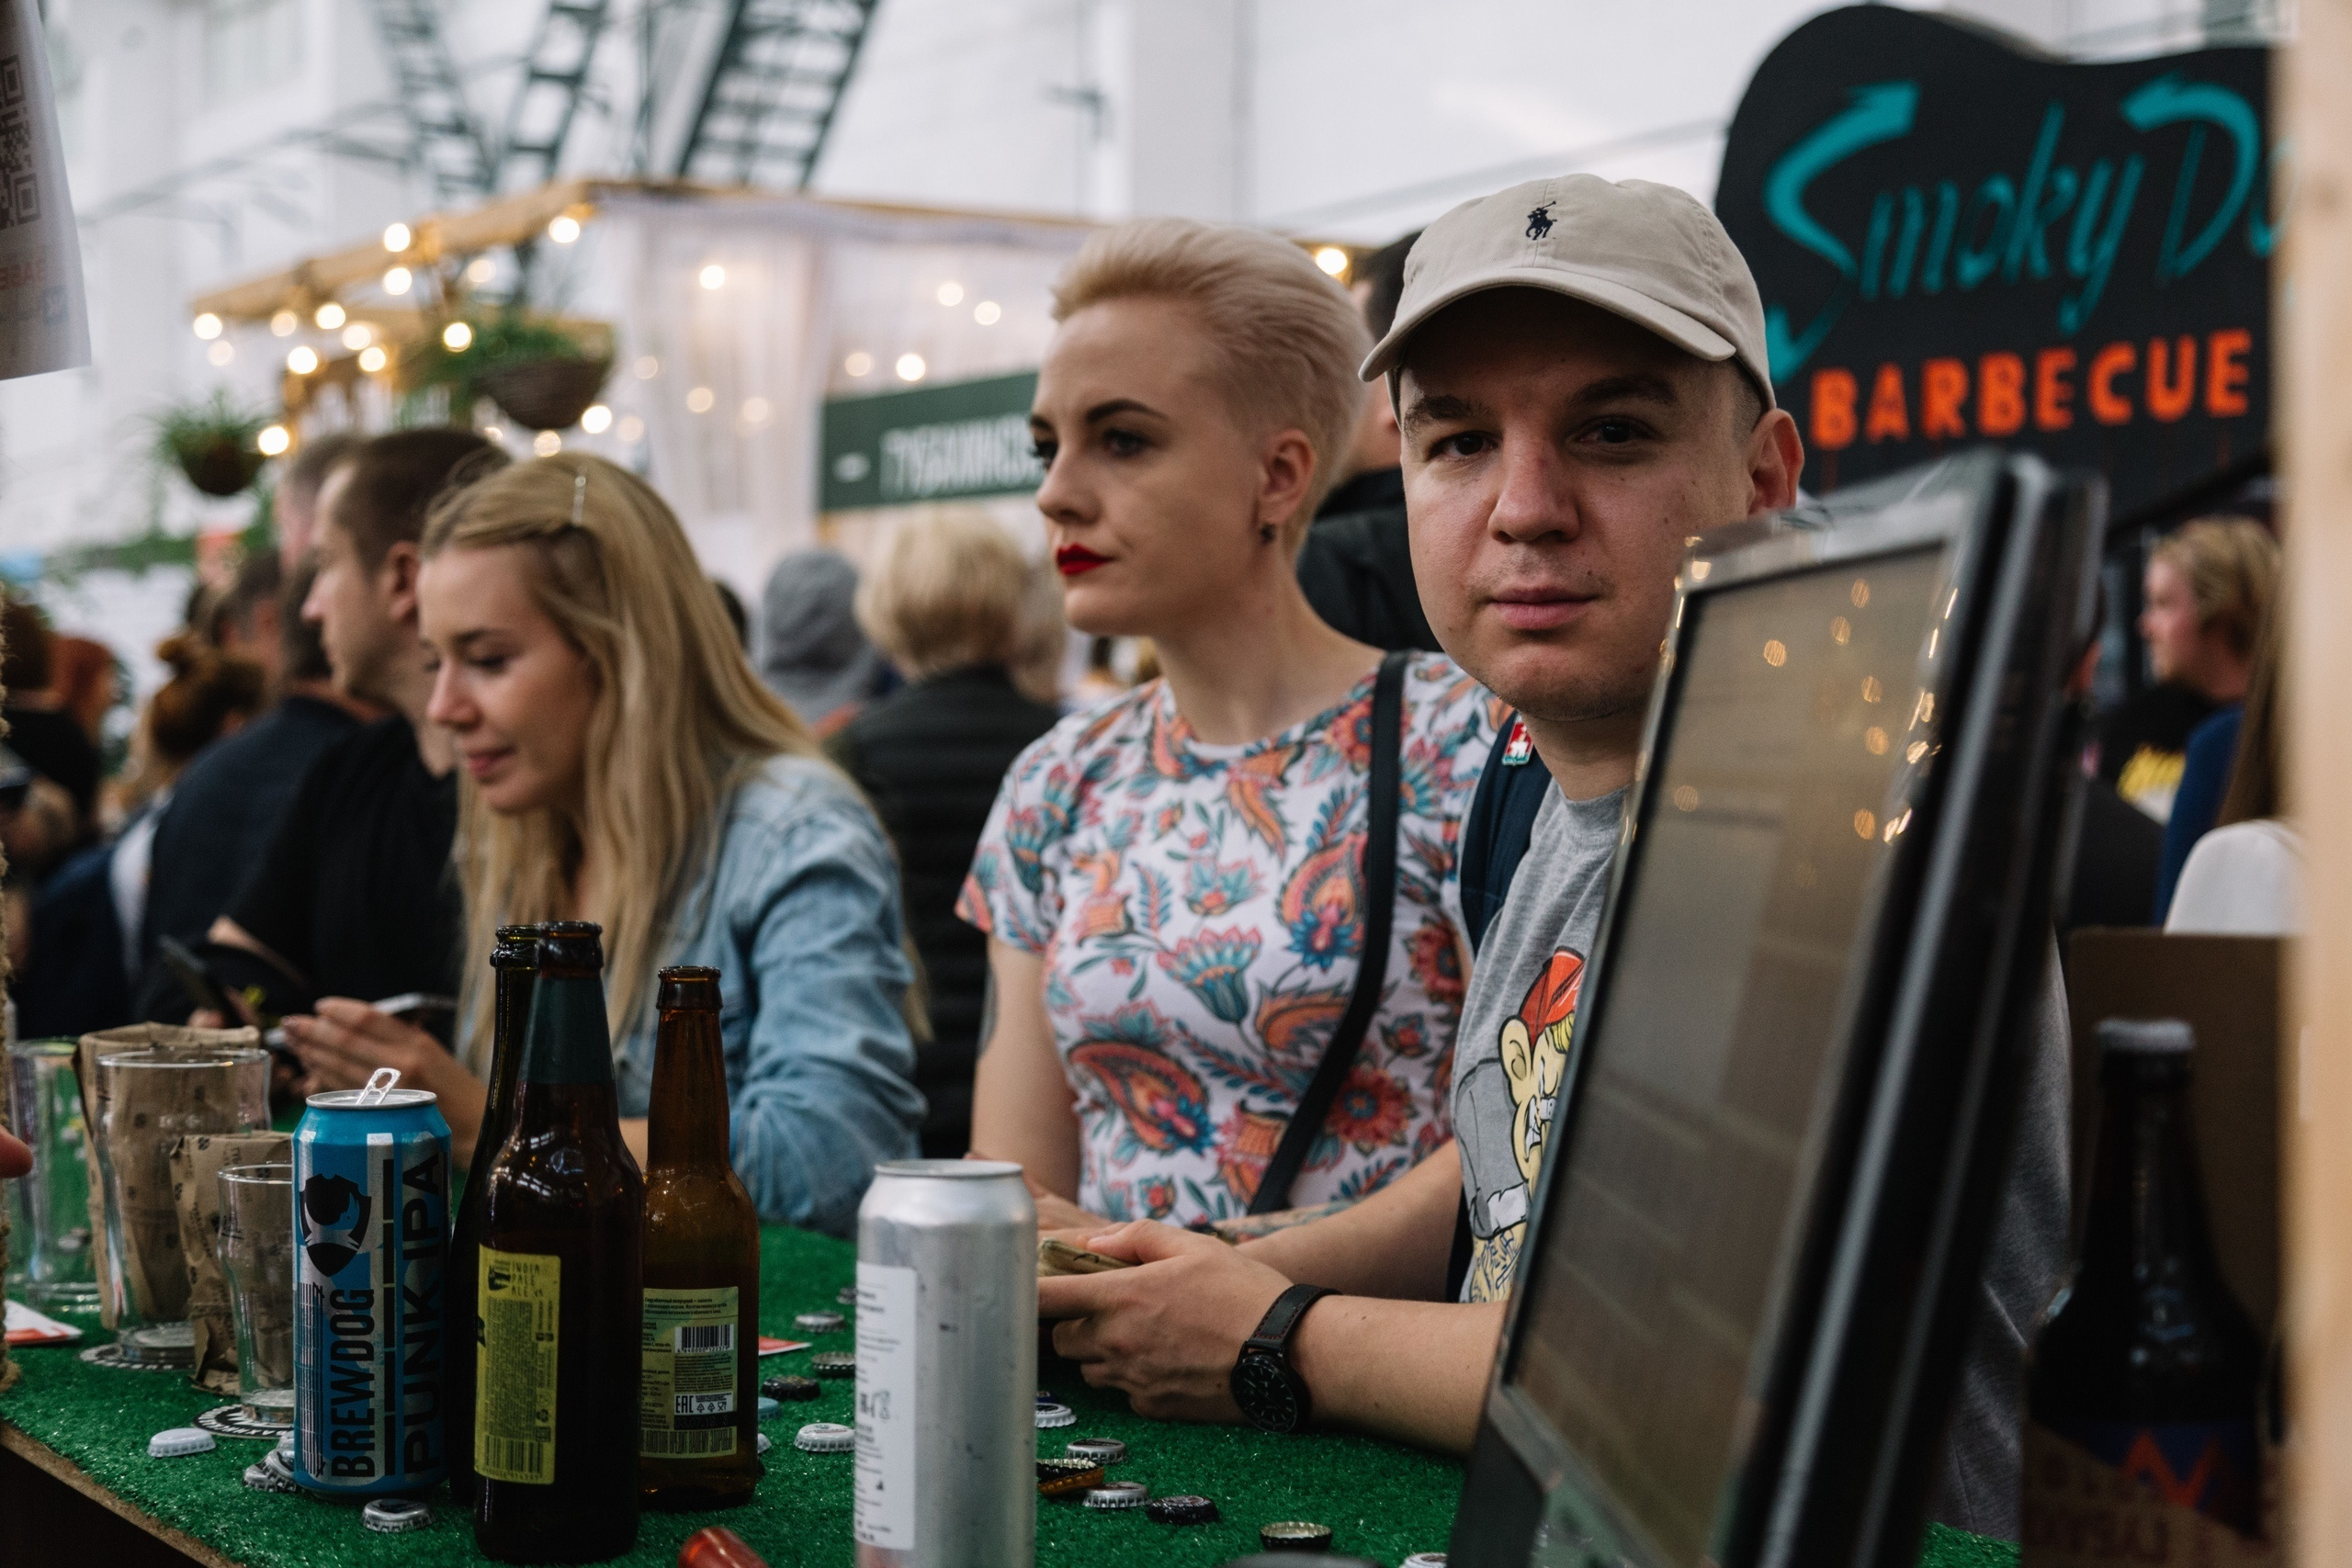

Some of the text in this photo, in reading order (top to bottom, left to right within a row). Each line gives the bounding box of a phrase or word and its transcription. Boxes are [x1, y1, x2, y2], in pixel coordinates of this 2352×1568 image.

[1765, 81, 2146, 385] Smoky
[1809, 328, 2254, 450] BARBECUE
[401, 1153, 443, 1475] PUNK IPA
[512, 1261, 540, 1275] INDIA
[512, 1273, 536, 1287] PALE
[330, 1288, 377, 1478] BREWDOG
[675, 1395, 695, 1414] EAC
